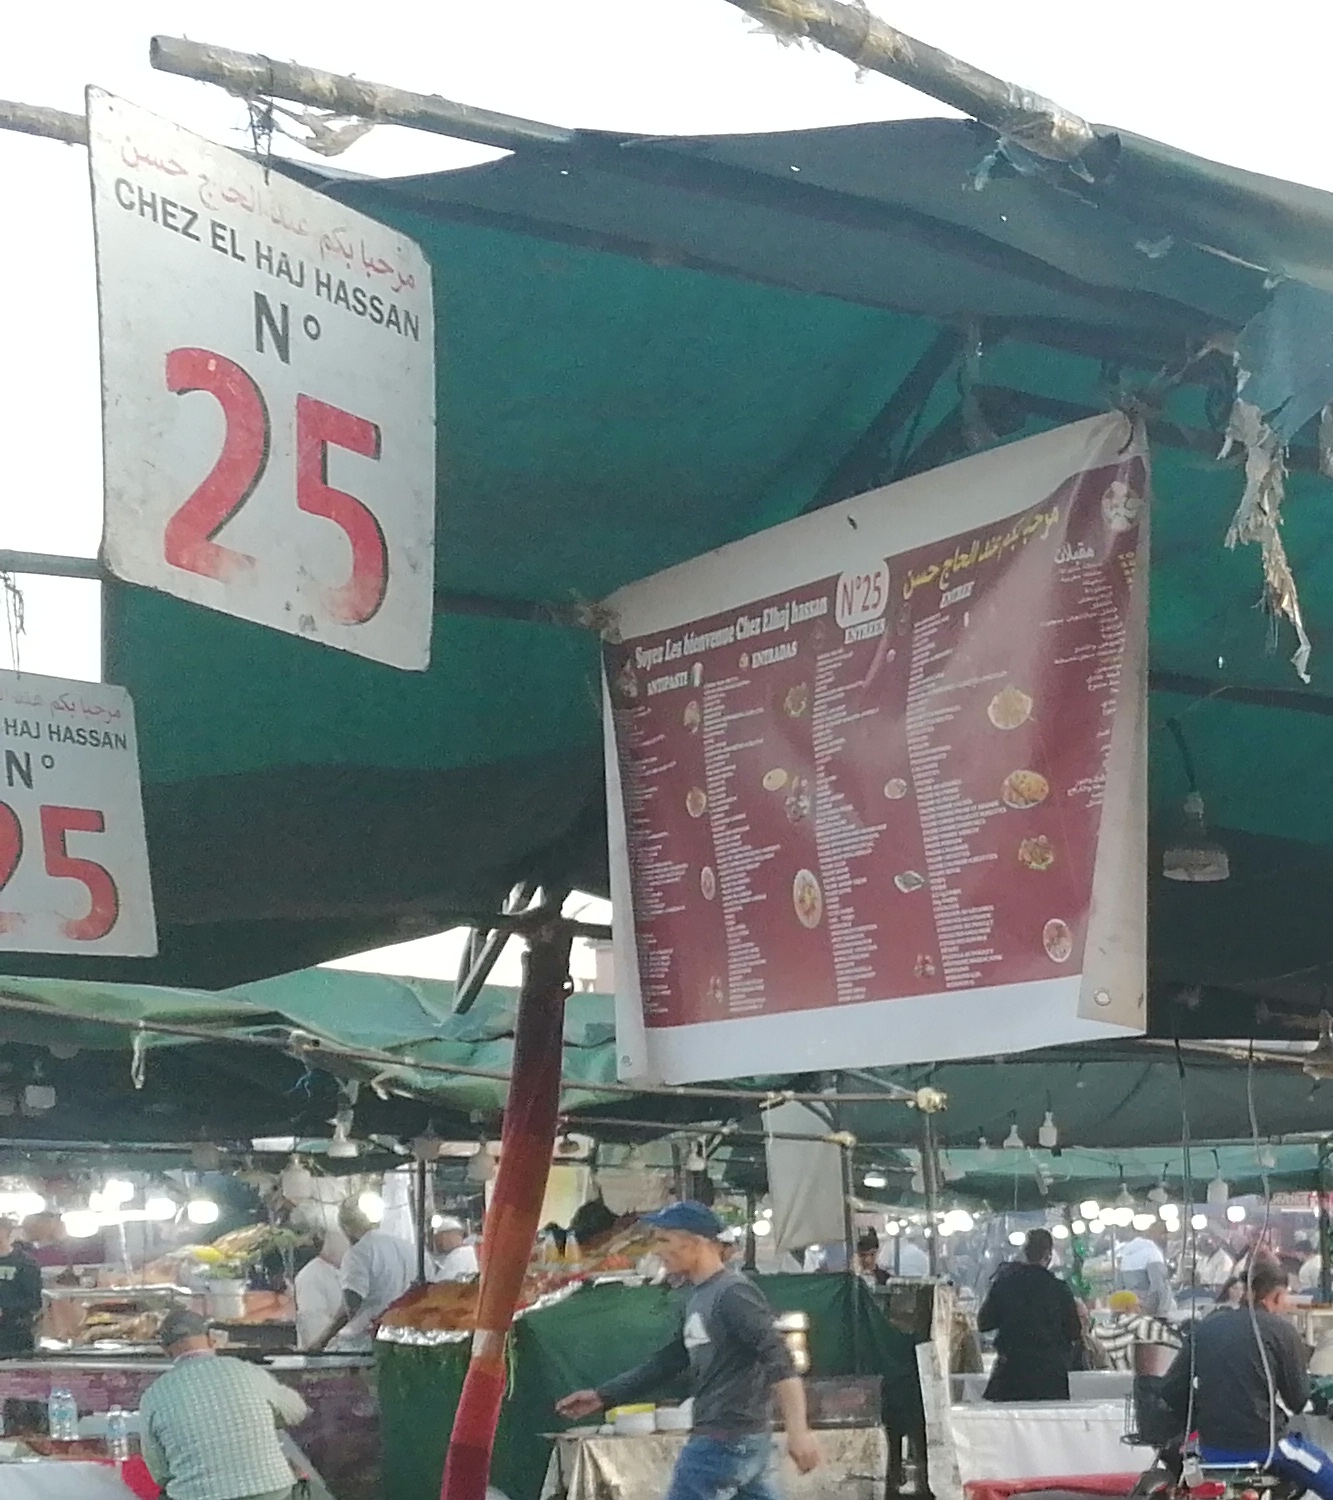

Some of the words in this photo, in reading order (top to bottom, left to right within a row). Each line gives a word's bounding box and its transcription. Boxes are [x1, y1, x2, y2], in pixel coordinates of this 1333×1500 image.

[120, 134, 189, 177] حسن
[114, 177, 201, 242] CHEZ
[210, 218, 246, 263] EL
[254, 239, 306, 289] HAJ
[314, 266, 421, 342] HASSAN
[320, 226, 354, 269] بكم
[360, 239, 416, 293] مرحبا
[164, 346, 391, 629] 25
[736, 615, 761, 640] Chez
[4, 717, 41, 739] HAJ
[48, 723, 127, 750] HASSAN
